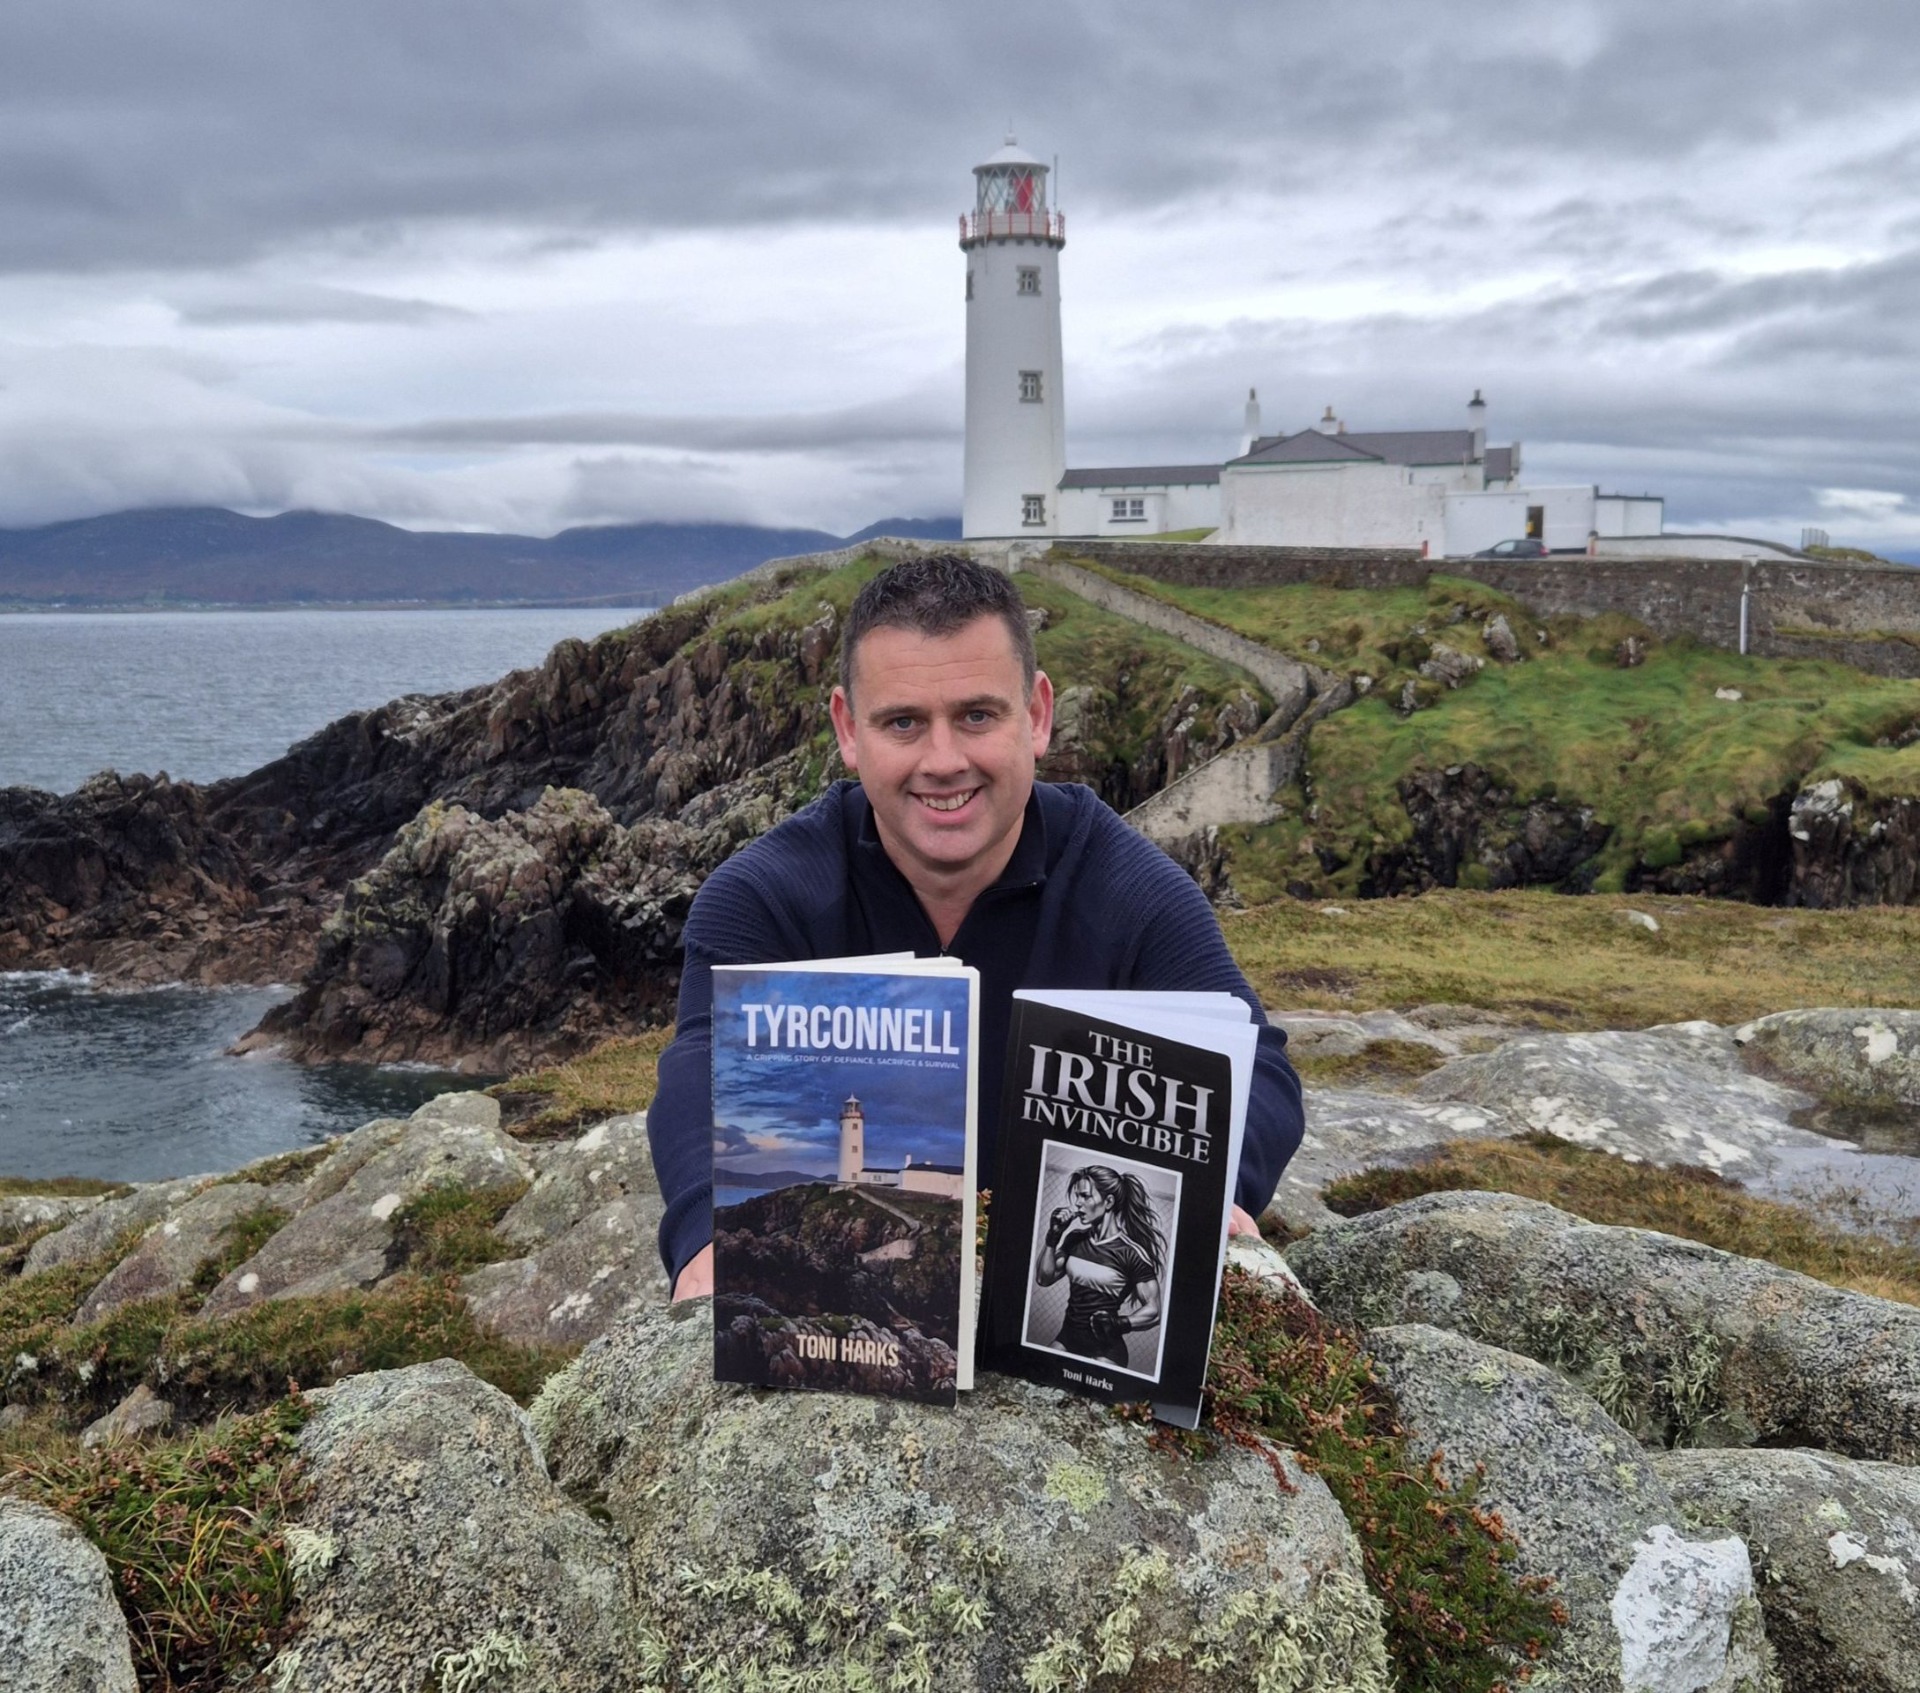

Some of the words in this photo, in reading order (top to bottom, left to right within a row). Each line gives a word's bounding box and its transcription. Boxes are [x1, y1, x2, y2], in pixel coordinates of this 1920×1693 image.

[742, 1004, 959, 1054] TYRCONNELL
[754, 1054, 793, 1062] GRIPPING
[794, 1055, 820, 1063] STORY
[877, 1058, 916, 1067] SACRIFICE
[917, 1059, 923, 1067] &
[924, 1059, 960, 1069] SURVIVAL
[1089, 1030, 1154, 1070] THE
[1024, 1044, 1215, 1138] IRISH
[1021, 1096, 1210, 1164] INVINCIBLE
[796, 1334, 837, 1362] TONI
[841, 1338, 900, 1367] HARKS
[1062, 1368, 1082, 1383] Toni
[1085, 1375, 1114, 1392] Harks
